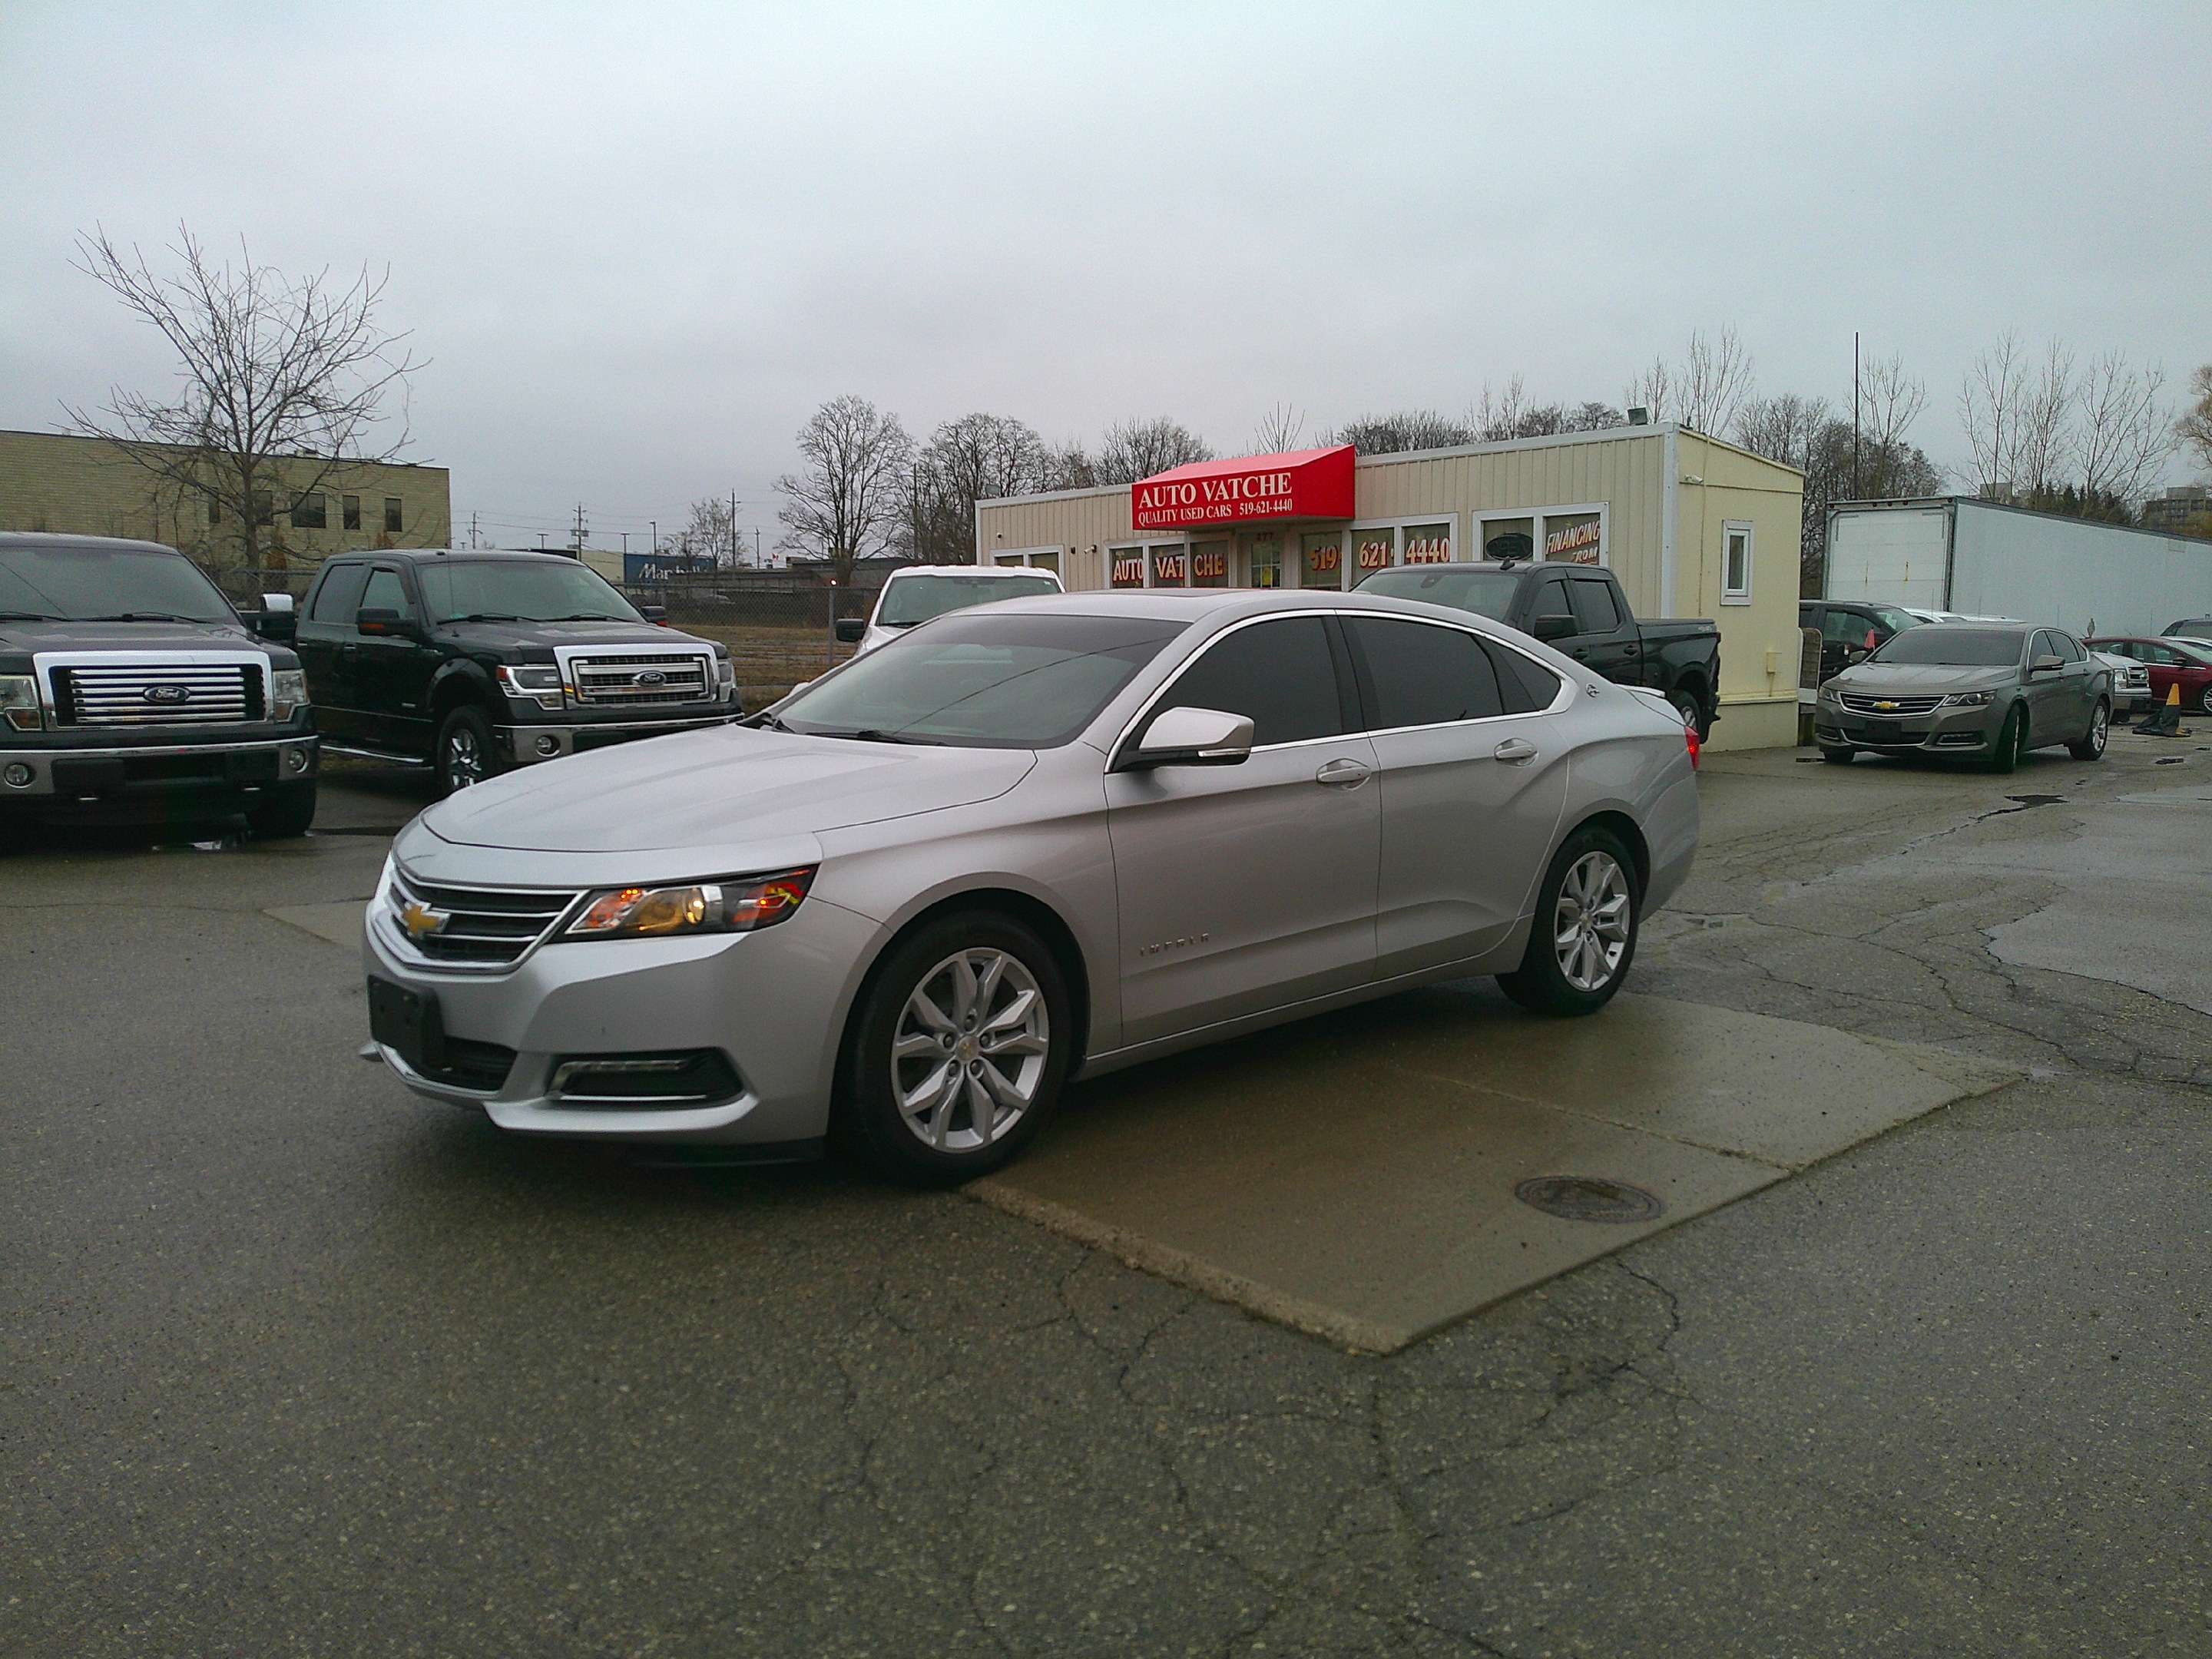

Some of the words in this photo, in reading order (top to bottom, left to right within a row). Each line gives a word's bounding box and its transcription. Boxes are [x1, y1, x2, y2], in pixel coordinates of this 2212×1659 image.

[1138, 483, 1197, 508] AUTO
[1202, 472, 1292, 502] VATCHE
[1138, 508, 1178, 526] QUALITY
[1181, 507, 1204, 521] USED
[1206, 504, 1232, 518] CARS
[1240, 498, 1293, 515] 519-621-4440
[1406, 538, 1450, 564] 4440
[1545, 520, 1600, 556] FINANCING
[1113, 558, 1143, 581] AUTO
